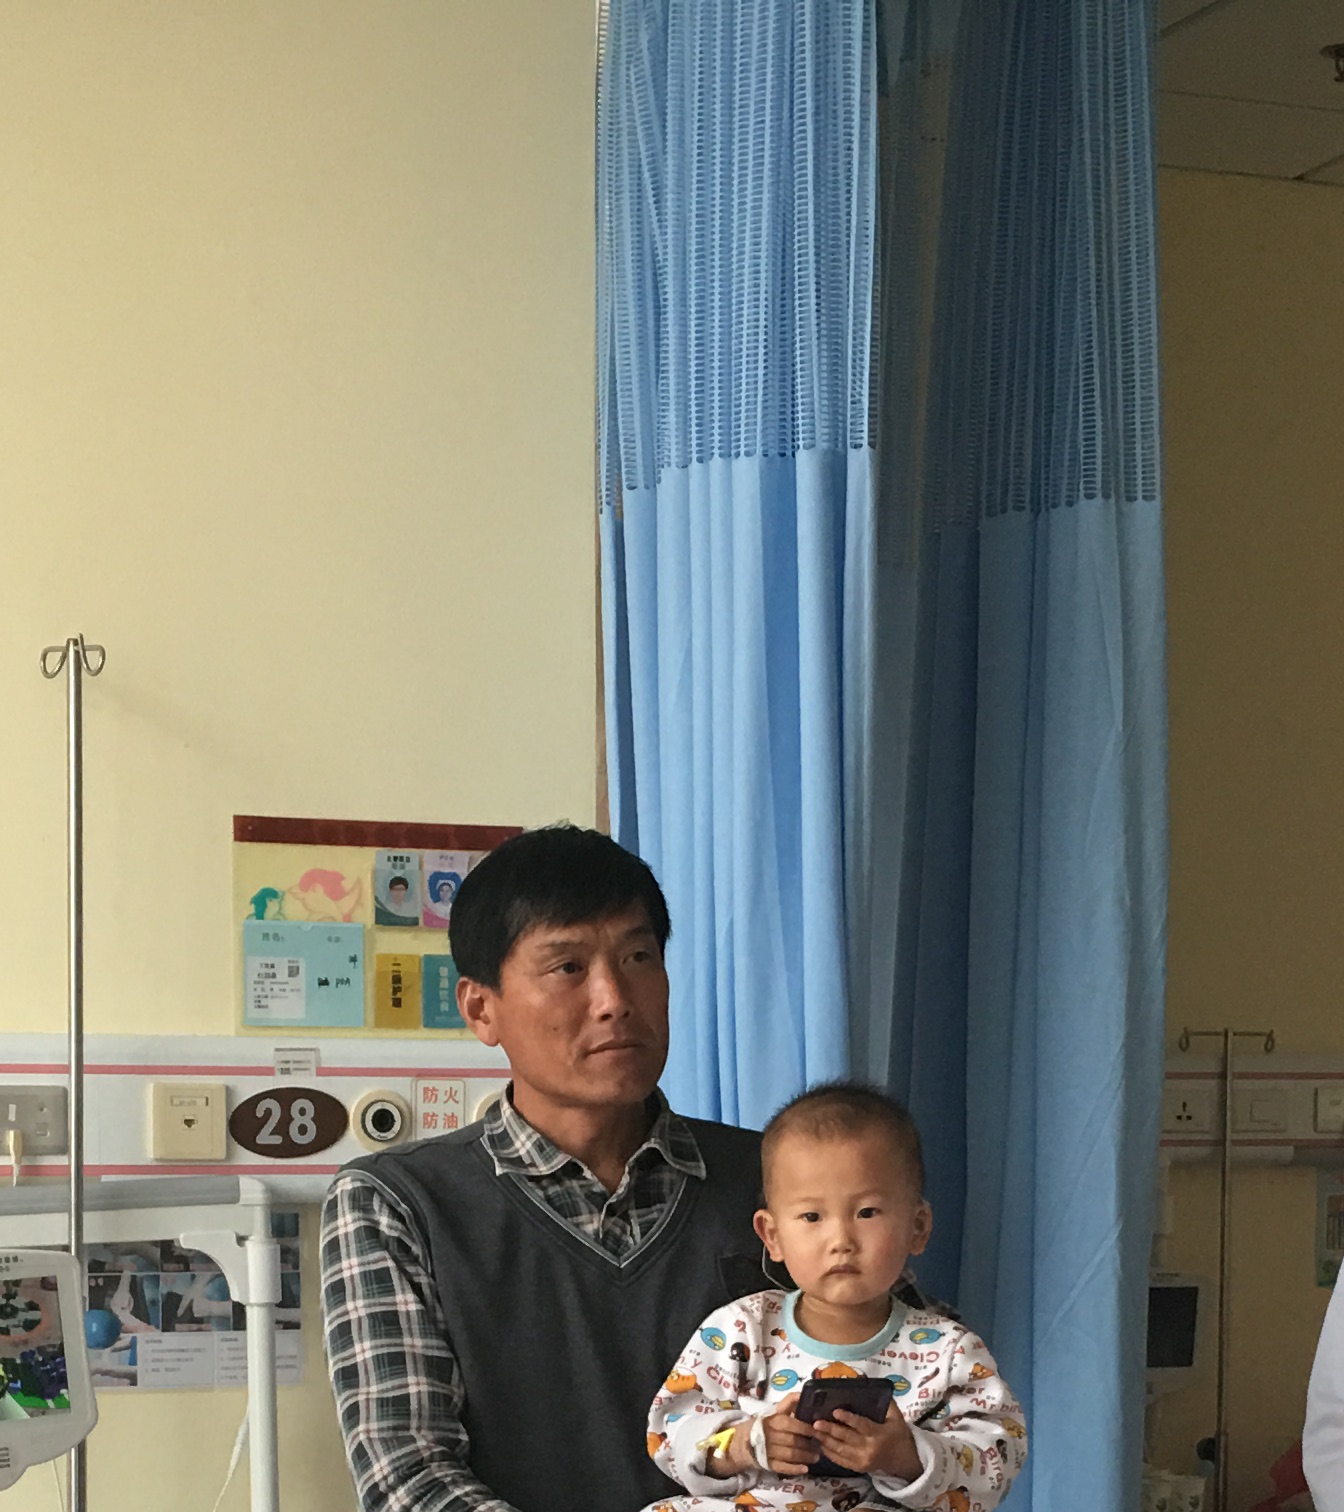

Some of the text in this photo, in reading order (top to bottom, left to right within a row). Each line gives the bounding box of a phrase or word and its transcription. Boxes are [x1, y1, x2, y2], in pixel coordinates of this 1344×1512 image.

[422, 1086, 460, 1104] 防火
[255, 1098, 317, 1145] 28
[422, 1112, 459, 1129] 防油
